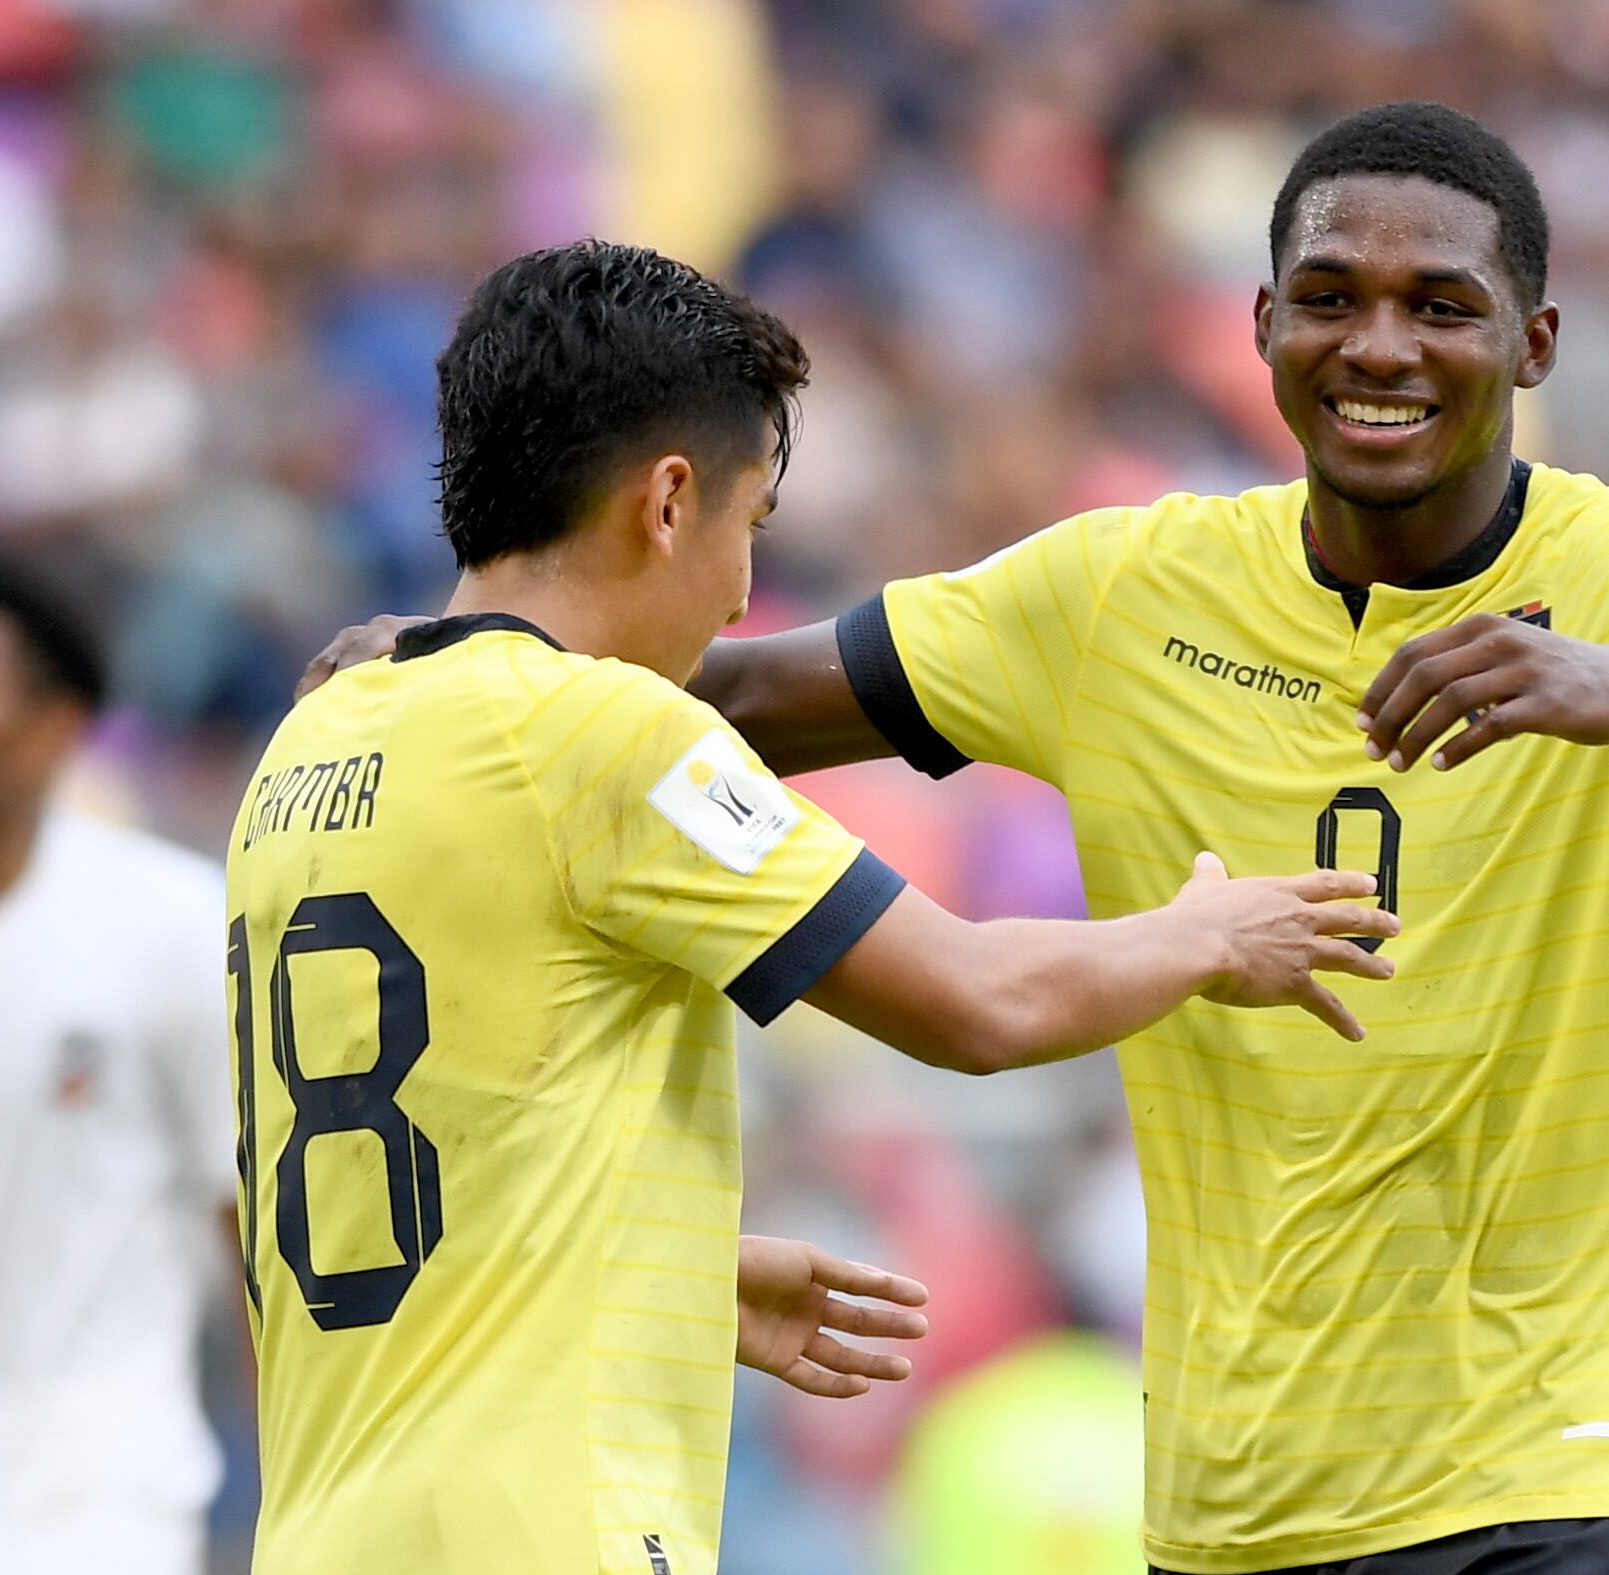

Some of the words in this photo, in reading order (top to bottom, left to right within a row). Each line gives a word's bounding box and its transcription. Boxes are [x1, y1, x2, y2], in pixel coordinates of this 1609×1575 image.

[1163, 636, 1322, 703] marathon
[243, 751, 384, 853] CHAMBA
[227, 891, 444, 1341] 18
